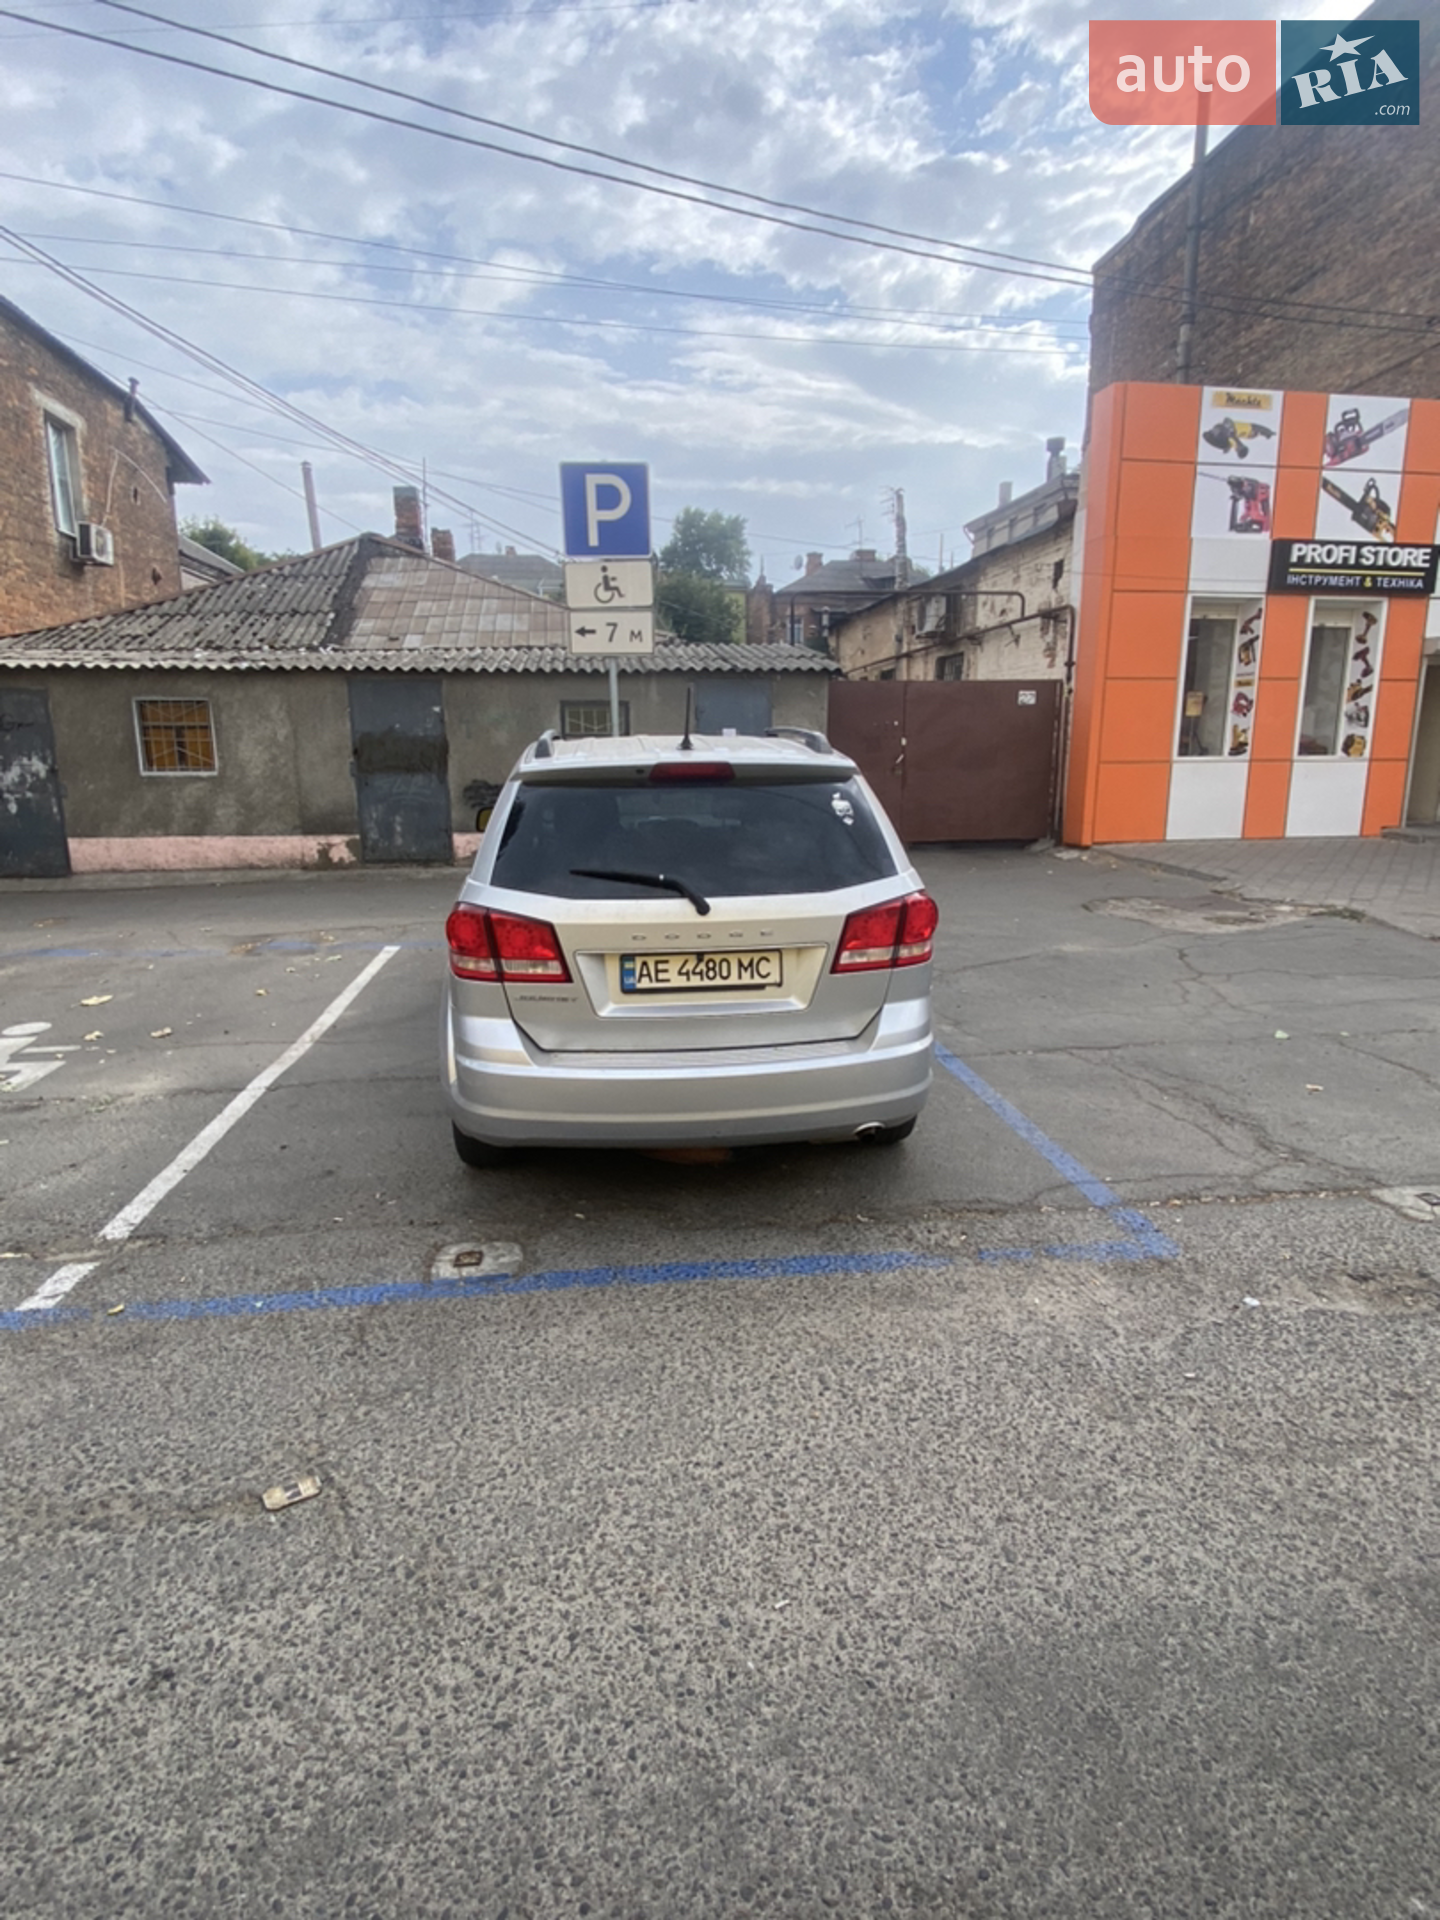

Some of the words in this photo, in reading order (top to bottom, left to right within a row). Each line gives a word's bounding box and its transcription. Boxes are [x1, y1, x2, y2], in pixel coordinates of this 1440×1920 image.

[585, 473, 632, 547] P
[1290, 543, 1357, 564] PROFI
[1359, 546, 1432, 567] STORE
[1286, 574, 1362, 586] ІНСТРУМЕНТ
[1363, 577, 1373, 588] &
[1376, 577, 1424, 589] ТЕХНІКА
[605, 622, 618, 642] 7
[637, 960, 671, 983] AE
[677, 957, 731, 982] 4480
[737, 956, 771, 980] MC
